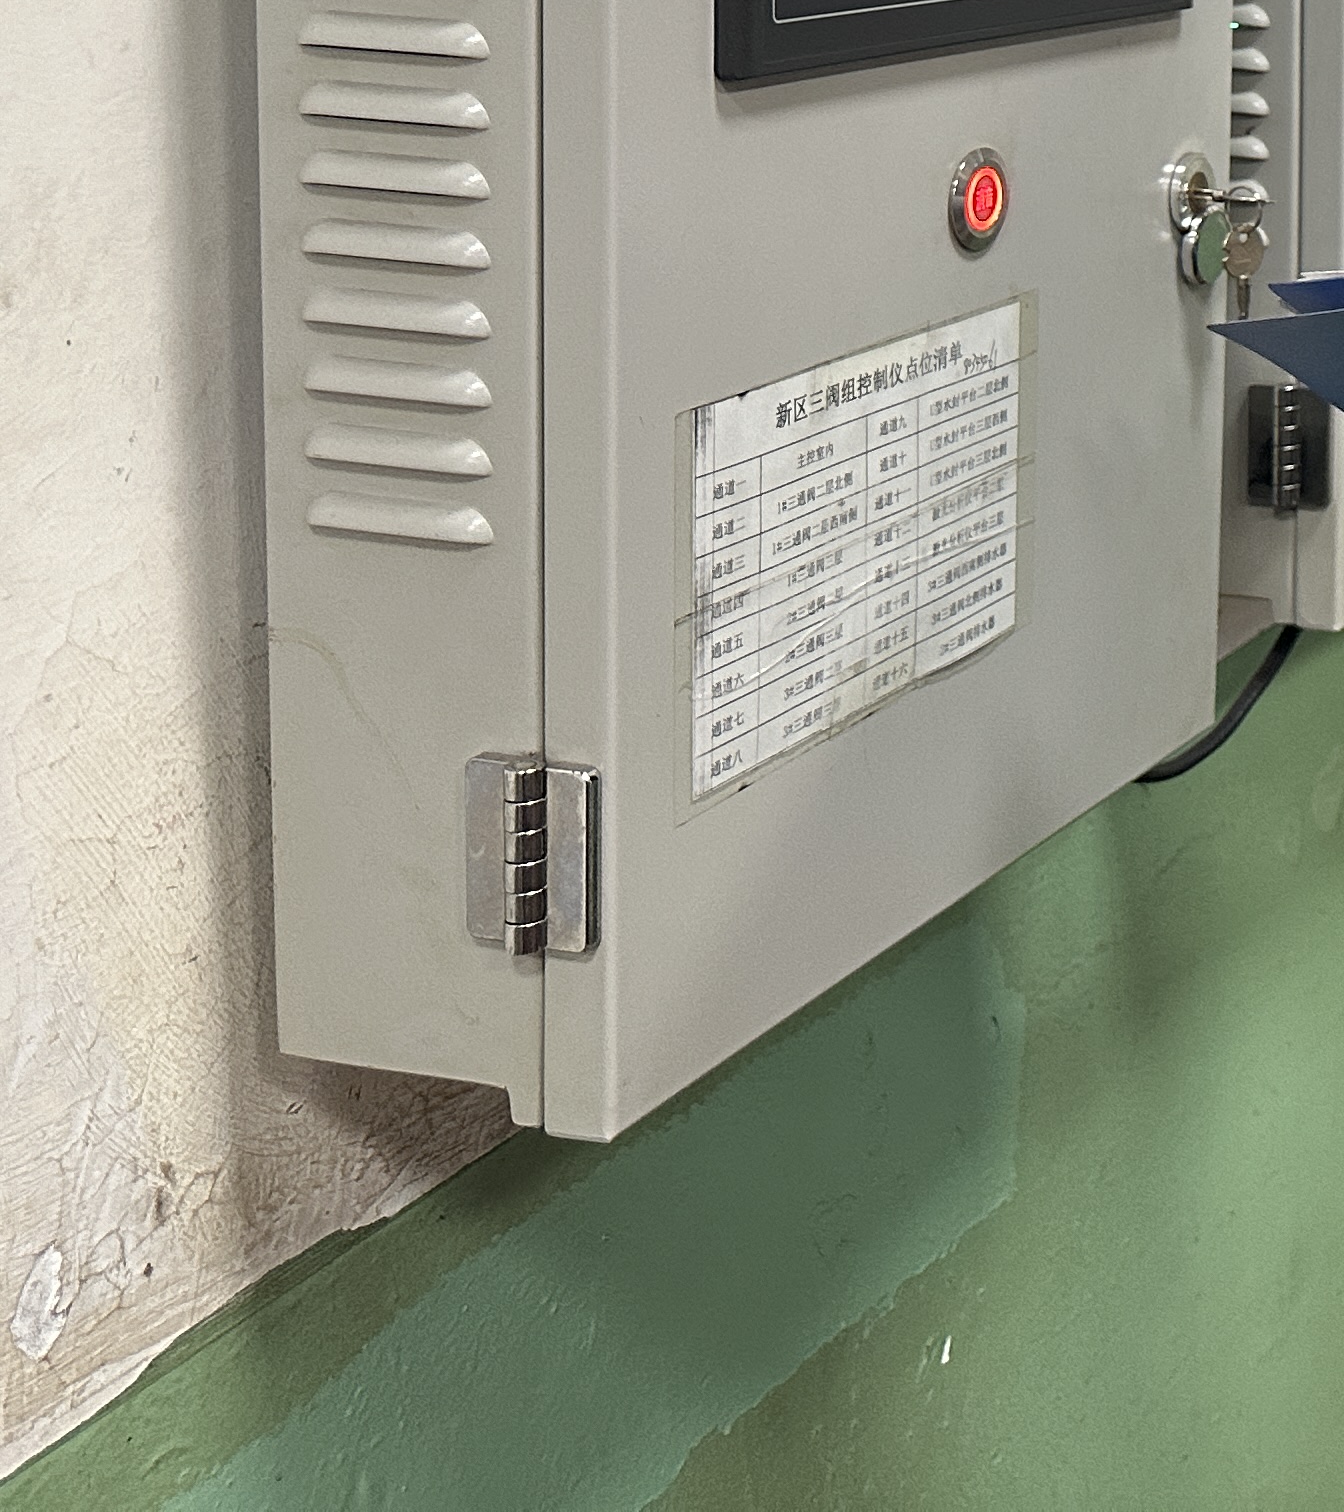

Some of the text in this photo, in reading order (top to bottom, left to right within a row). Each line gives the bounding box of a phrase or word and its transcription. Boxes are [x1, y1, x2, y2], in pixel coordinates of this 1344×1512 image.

[775, 340, 963, 429] 新区三阀组控制仪点位清单
[713, 479, 747, 500] 通道一
[797, 442, 834, 469] 主控室内
[879, 416, 907, 436] 通道九
[713, 516, 746, 540] 通道二
[778, 471, 854, 514] 1#三通阀二层北侧
[880, 452, 907, 472] 通道十
[712, 555, 745, 579] 通道三
[875, 488, 912, 511] 通道十一
[711, 632, 743, 659] 通道五
[711, 672, 745, 699] 通道六
[711, 711, 744, 738] 通道七
[711, 750, 743, 778] 通道八
